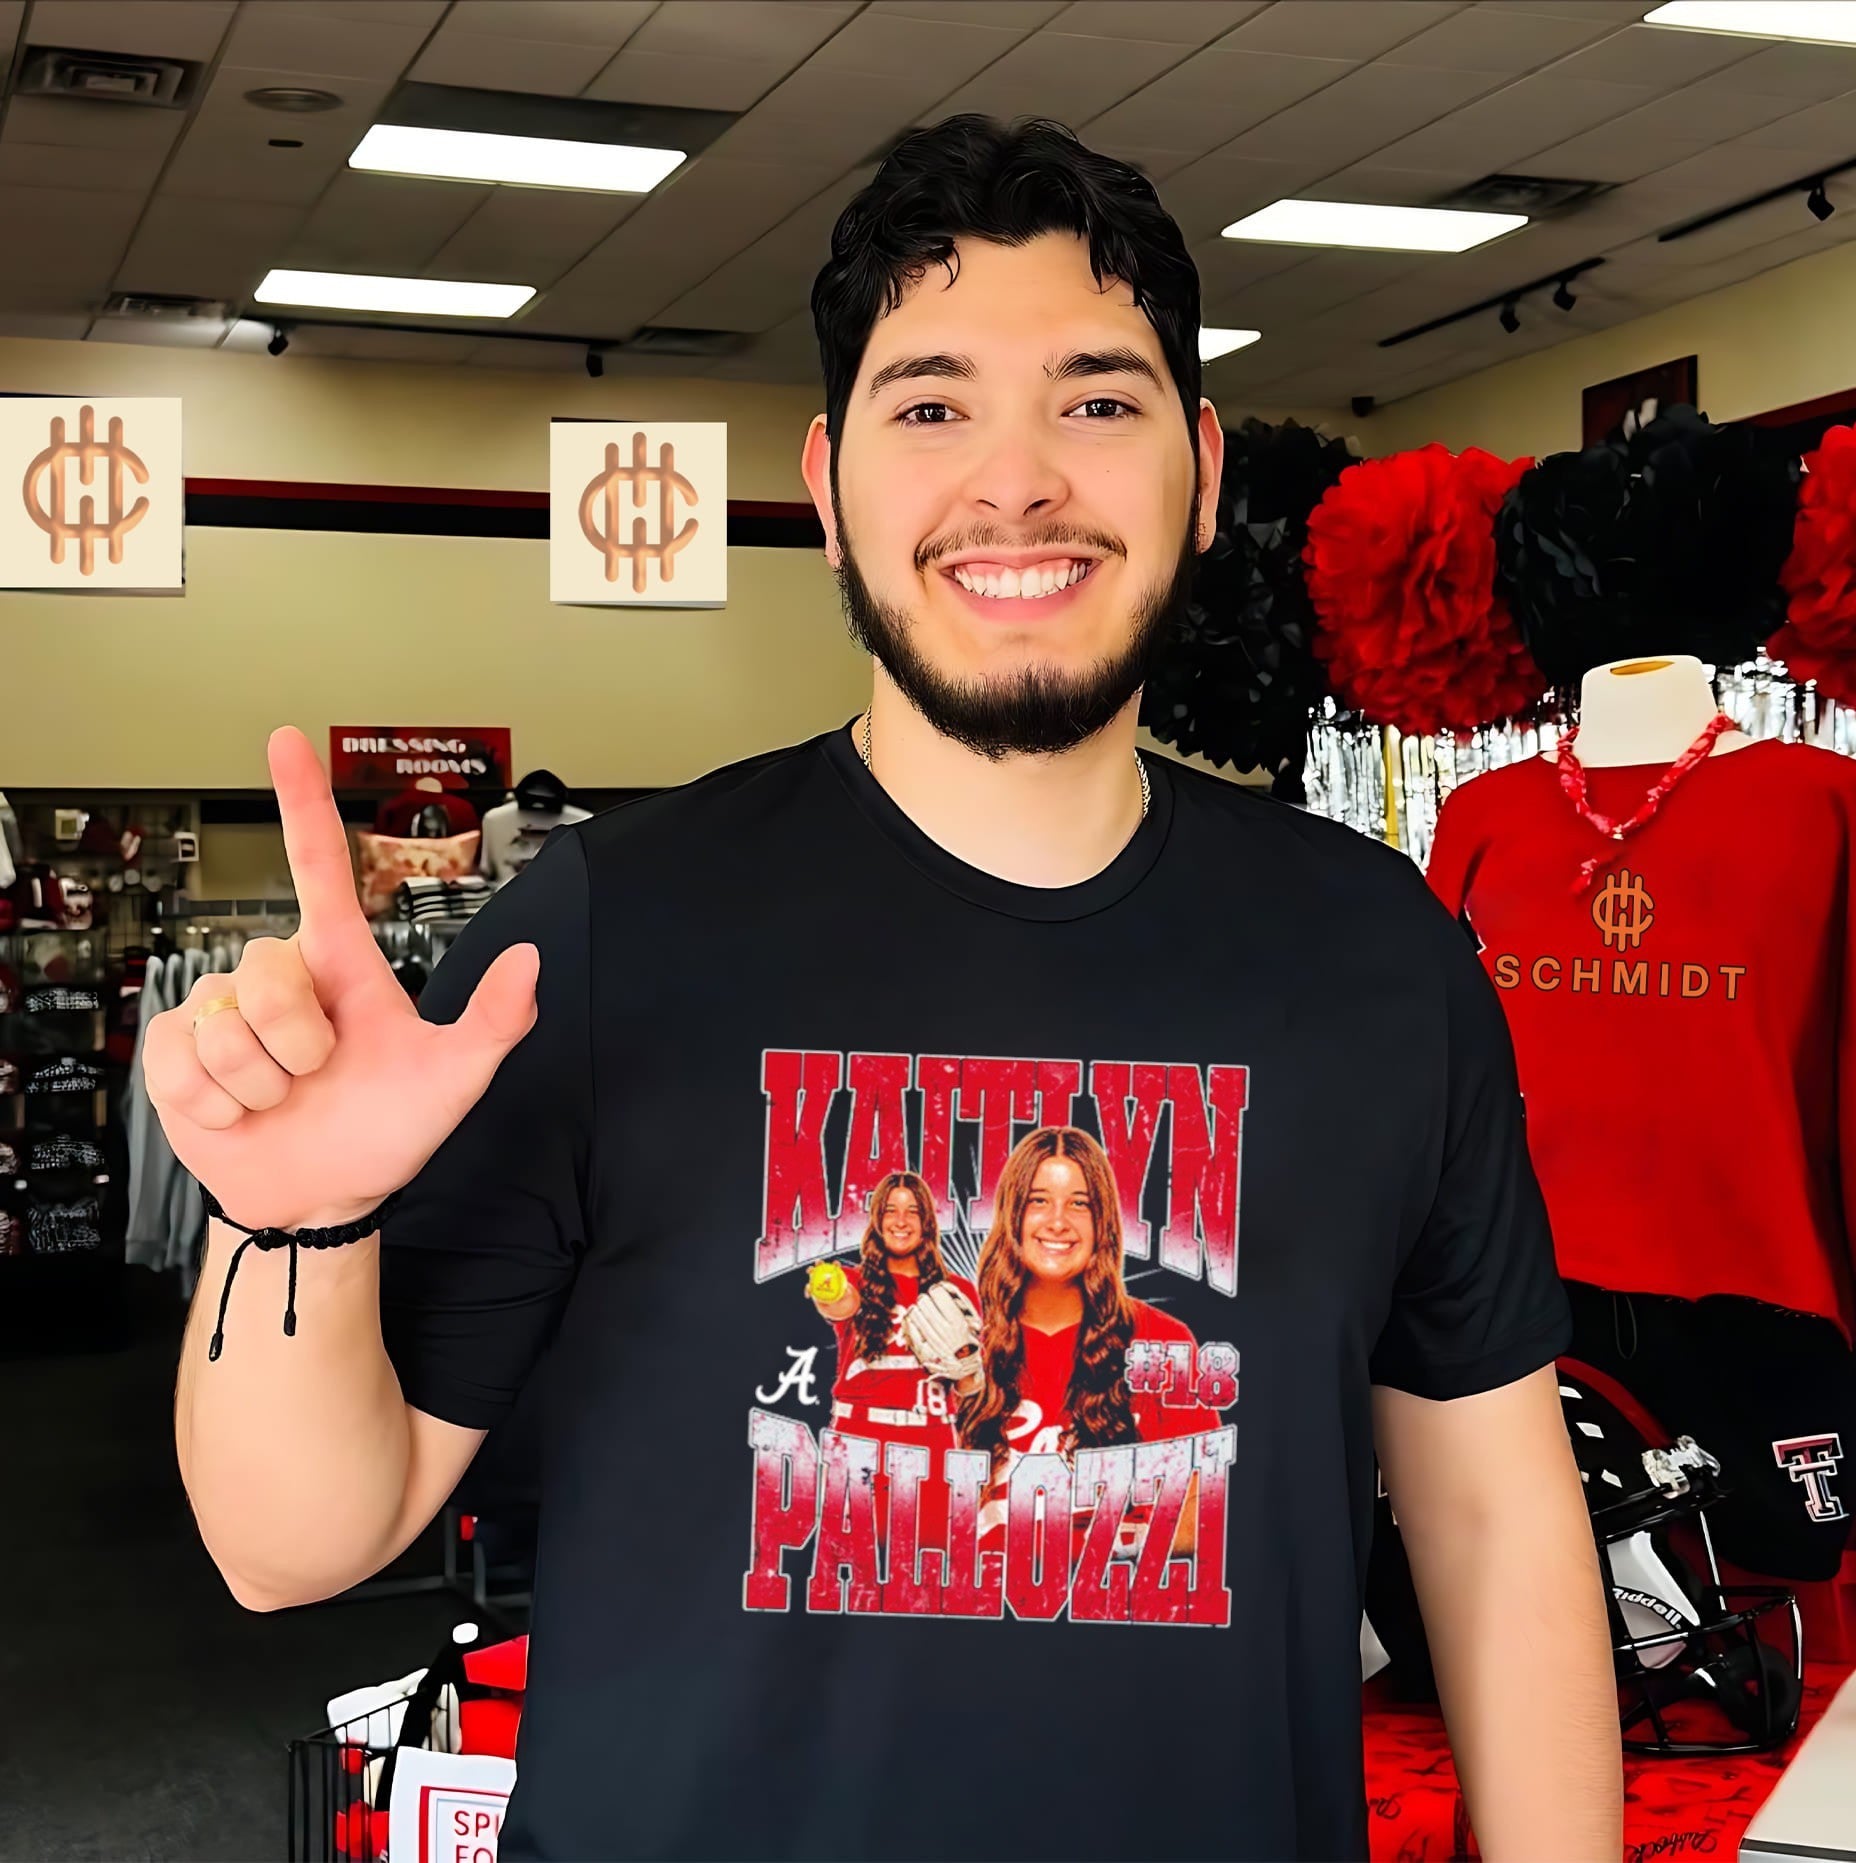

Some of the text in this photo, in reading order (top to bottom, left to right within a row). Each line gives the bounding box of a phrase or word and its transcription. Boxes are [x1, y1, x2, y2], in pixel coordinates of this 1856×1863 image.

[396, 758, 487, 775] ROOMS
[1494, 954, 1747, 1000] SCHMIDT
[755, 1345, 819, 1406] A
[1125, 1340, 1240, 1410] #18
[743, 1407, 1236, 1628] PALLOZZI
